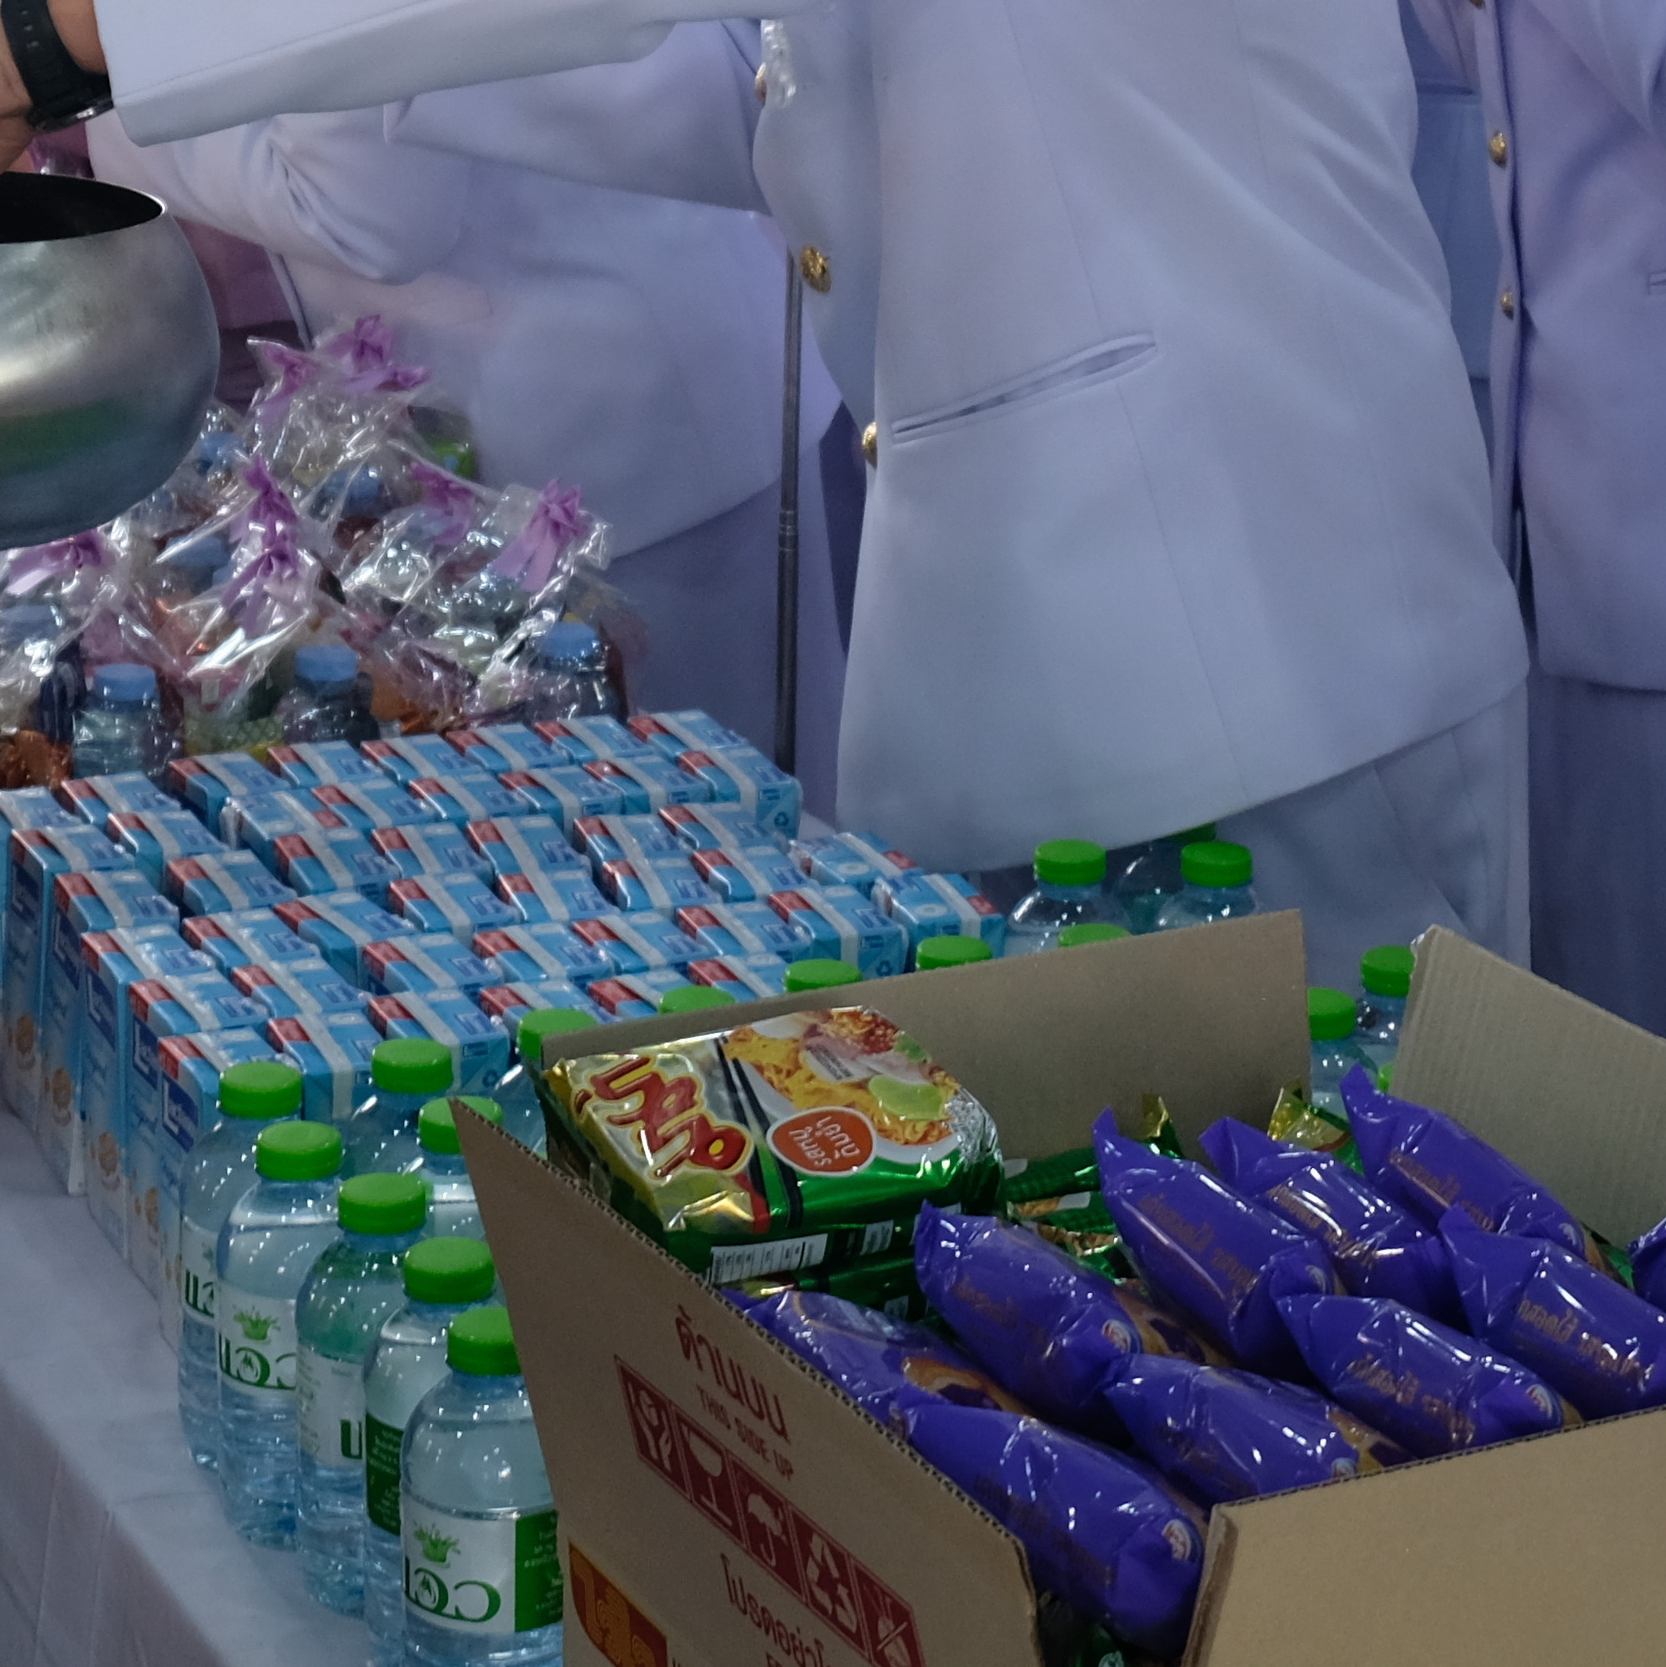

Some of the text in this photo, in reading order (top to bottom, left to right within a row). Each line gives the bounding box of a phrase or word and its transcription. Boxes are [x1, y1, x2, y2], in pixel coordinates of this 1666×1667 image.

[676, 1304, 790, 1442] ด้านบน
[696, 1385, 795, 1481] THIS SIDE UP
